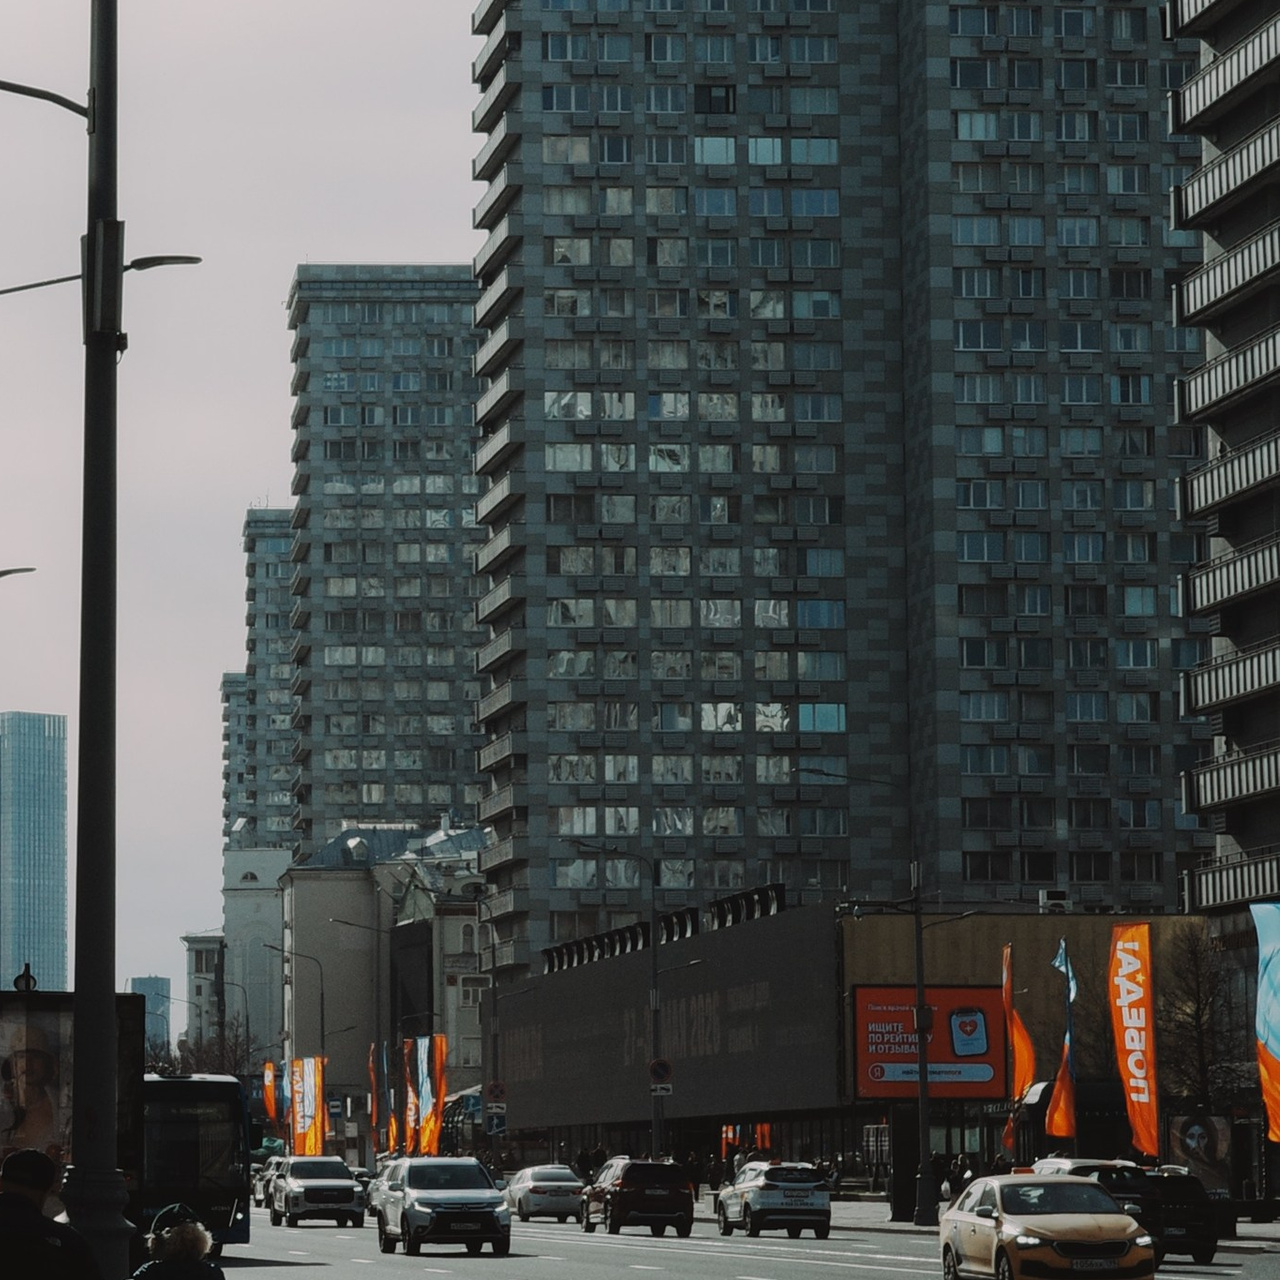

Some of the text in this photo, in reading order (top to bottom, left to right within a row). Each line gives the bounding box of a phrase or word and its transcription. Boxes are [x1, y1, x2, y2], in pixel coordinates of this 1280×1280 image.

[868, 1022, 905, 1033] ИЩИТЕ
[868, 1032, 934, 1043] ПО РЕЙТИУ
[868, 1044, 920, 1053] И ОТЗЫВА
[874, 1067, 881, 1079] Я
